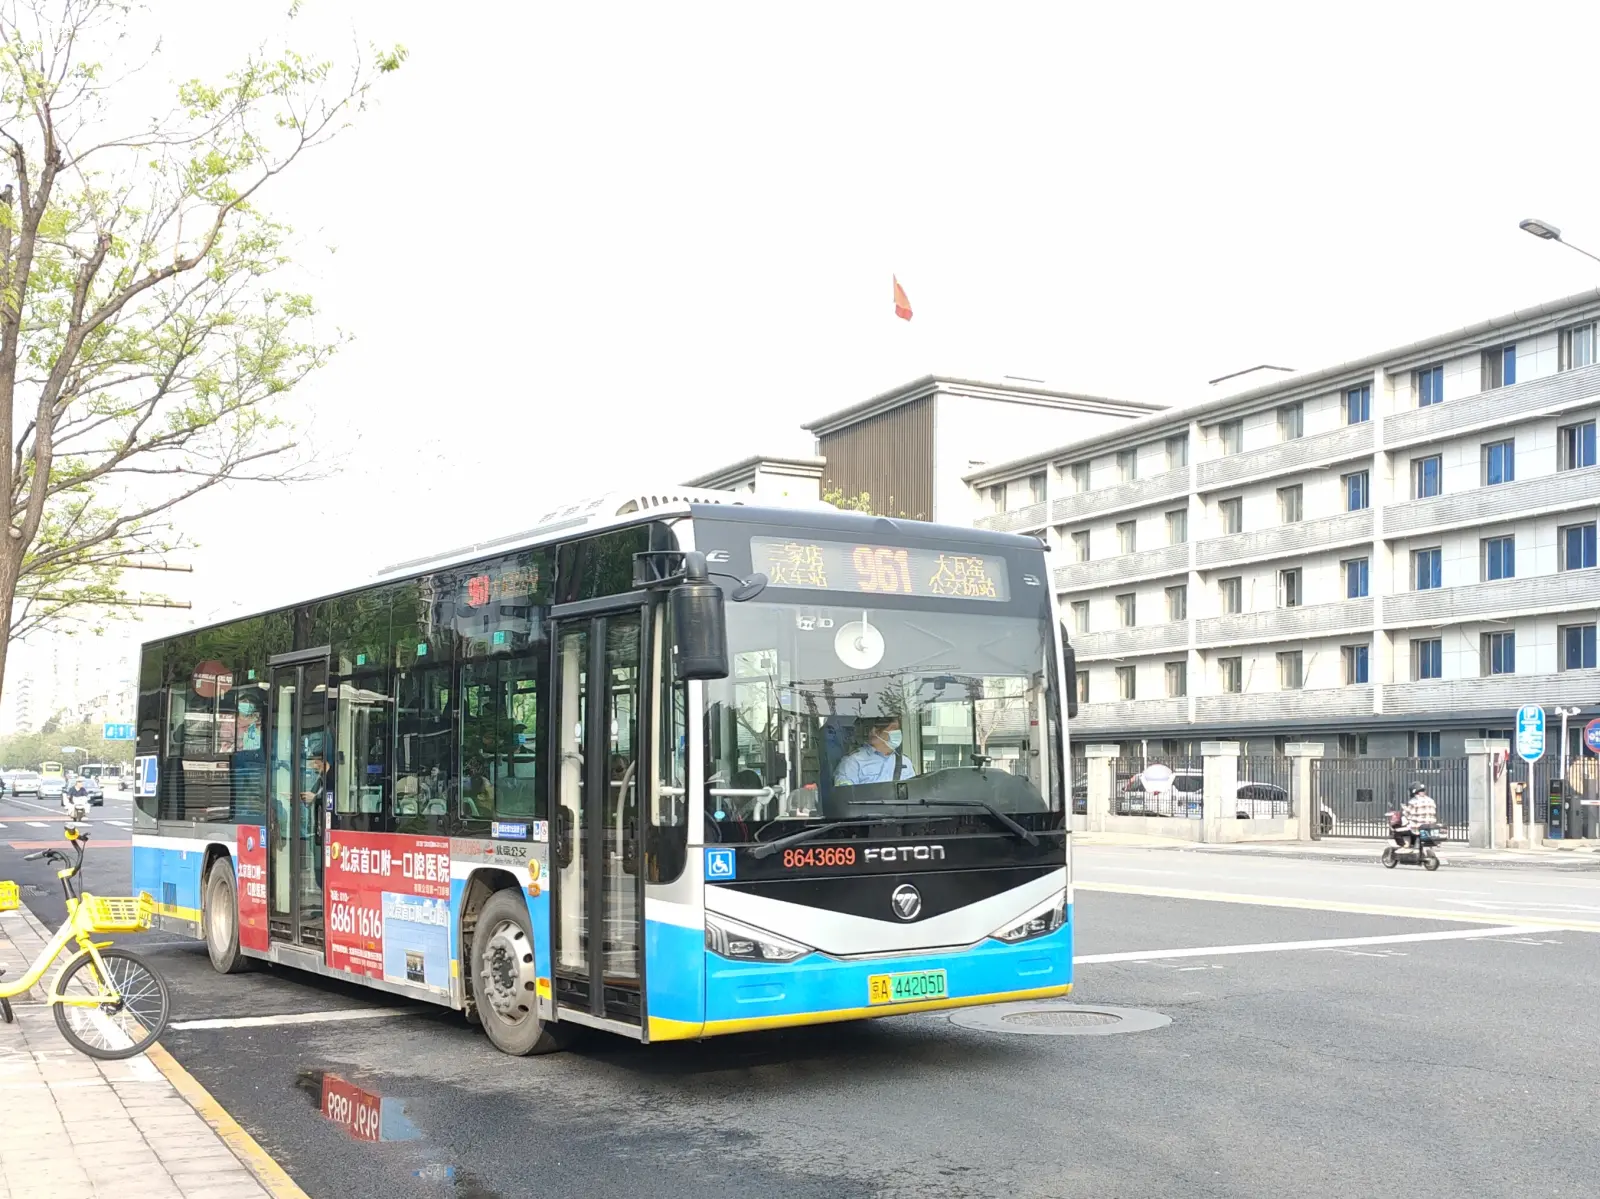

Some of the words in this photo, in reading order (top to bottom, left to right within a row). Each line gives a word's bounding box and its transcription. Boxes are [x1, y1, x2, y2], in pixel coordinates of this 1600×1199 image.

[767, 543, 824, 565] 三家店
[771, 562, 828, 588] 火车站
[852, 547, 912, 593] 961
[931, 555, 985, 580] 大瓦窑
[929, 575, 996, 598] 公交场站
[496, 845, 528, 858] 北京公交
[783, 847, 856, 868] 8643669
[864, 845, 945, 862] FOTON
[340, 846, 449, 883] 北京首口附一口腔医院
[895, 974, 944, 997] 44205D
